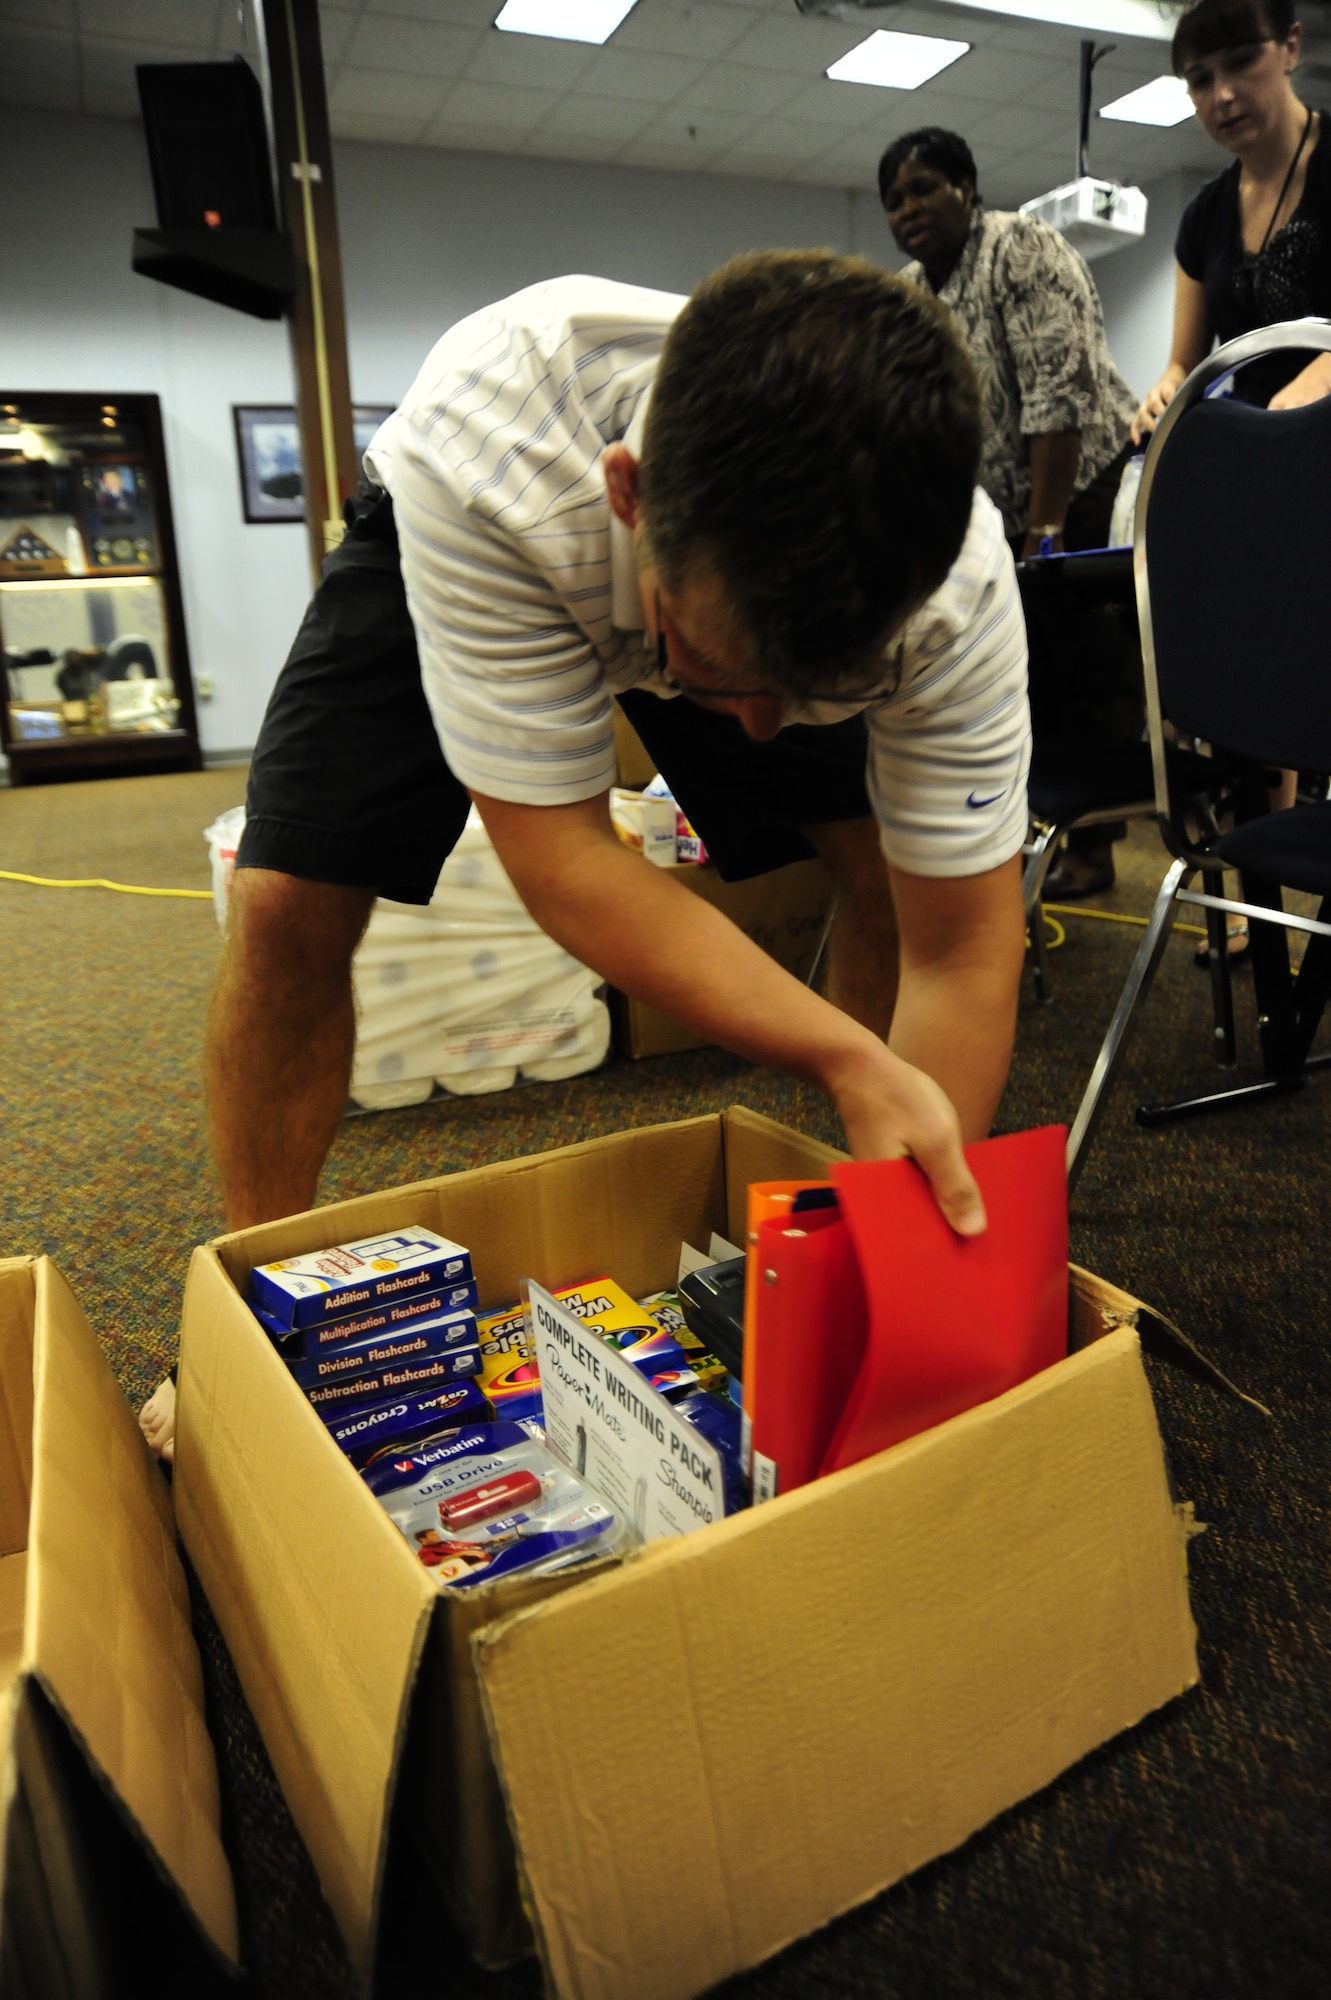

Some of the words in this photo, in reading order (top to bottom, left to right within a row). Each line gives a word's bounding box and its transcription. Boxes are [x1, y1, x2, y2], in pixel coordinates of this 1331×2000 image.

[324, 1288, 370, 1310] Addition
[376, 1271, 430, 1295] Flashcards
[319, 1315, 386, 1343] Multiplication
[391, 1298, 441, 1320] Flashcards
[318, 1355, 363, 1375] Division
[368, 1338, 428, 1362] Flashcards
[309, 1378, 379, 1403] Subtraction
[382, 1362, 445, 1386] Flashcards
[537, 1304, 601, 1381] COMPLETE
[604, 1367, 665, 1443] WRITING
[670, 1430, 714, 1492] PACK
[545, 1342, 586, 1398] Paper
[590, 1393, 626, 1441] Mate
[335, 1404, 408, 1440] Crayons
[411, 1434, 486, 1468] Verbatim
[418, 1478, 455, 1495] USB
[458, 1460, 503, 1481] Drive
[655, 1459, 713, 1524] Sharpie
